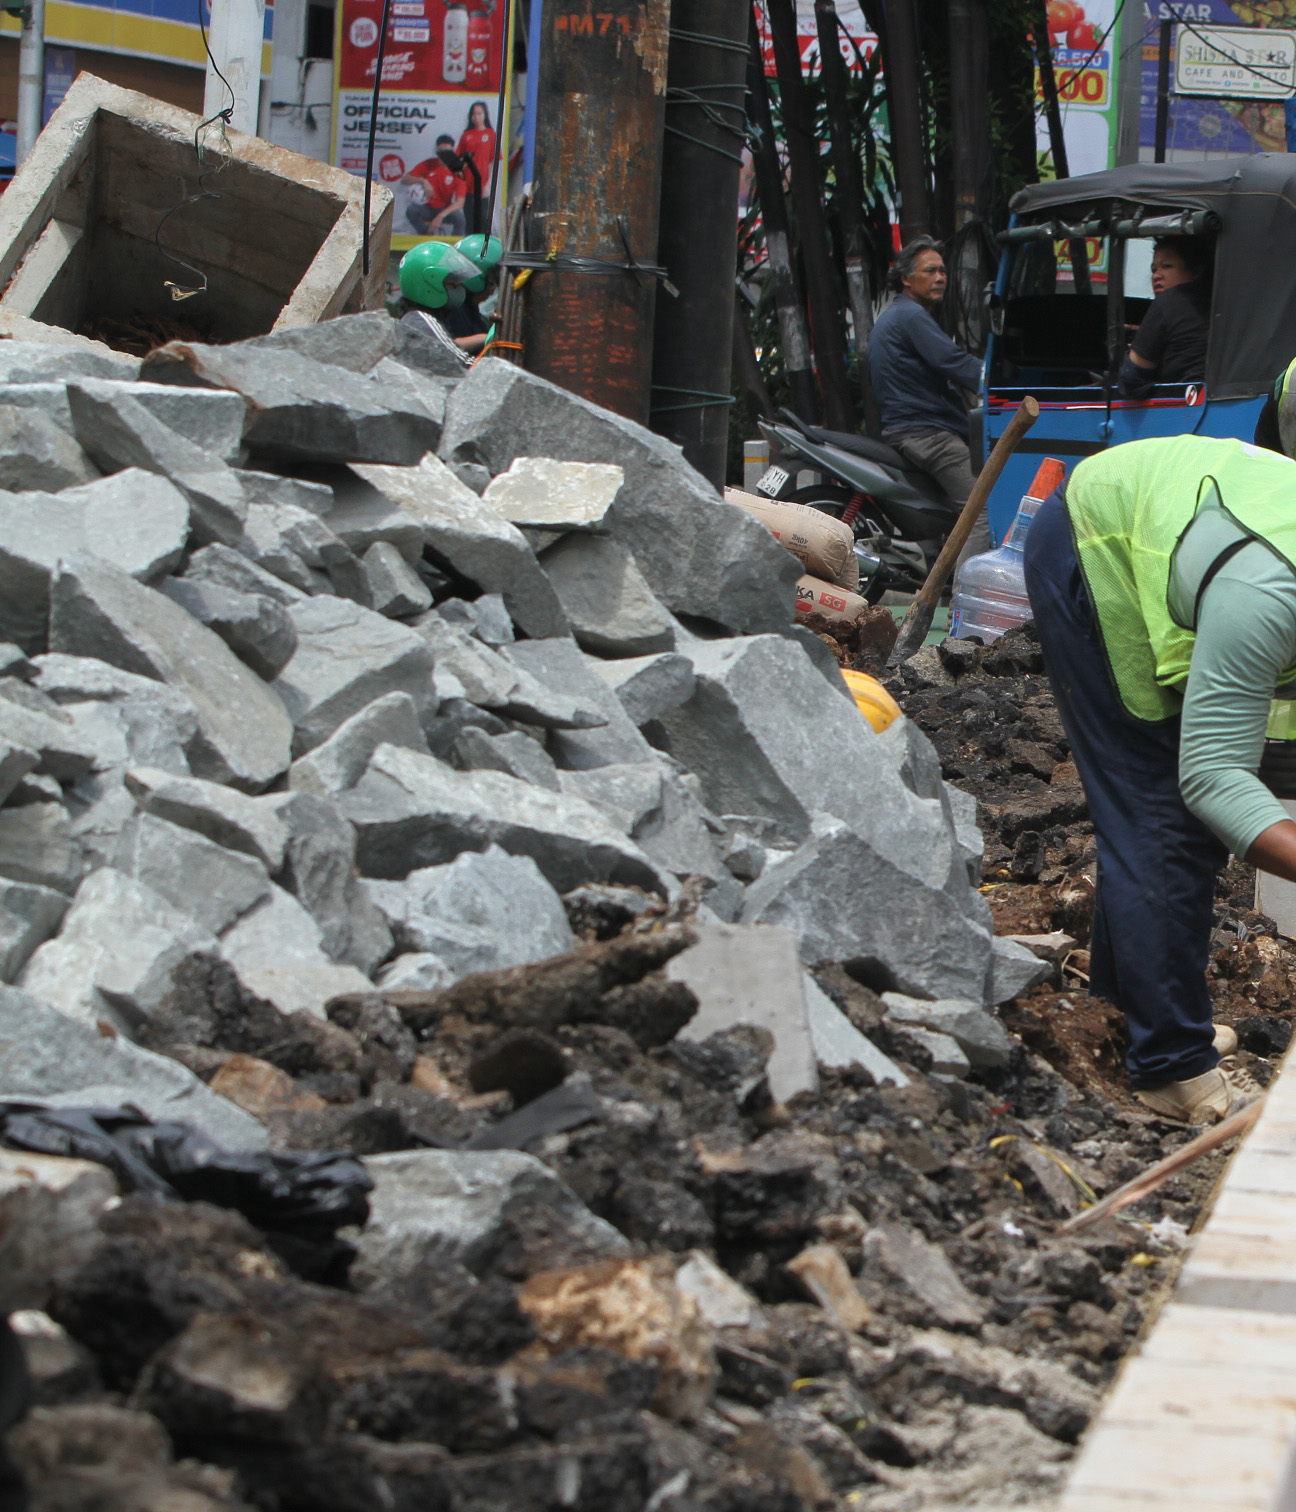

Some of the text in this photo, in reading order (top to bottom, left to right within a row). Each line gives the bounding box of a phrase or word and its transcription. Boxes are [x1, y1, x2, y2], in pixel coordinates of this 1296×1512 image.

[1158, 2, 1212, 22] STAR
[1184, 67, 1213, 78] CAFE
[1222, 70, 1244, 80] AND
[343, 104, 436, 120] OFFICIAL
[343, 121, 428, 134] JERSEY
[824, 595, 843, 609] SG
